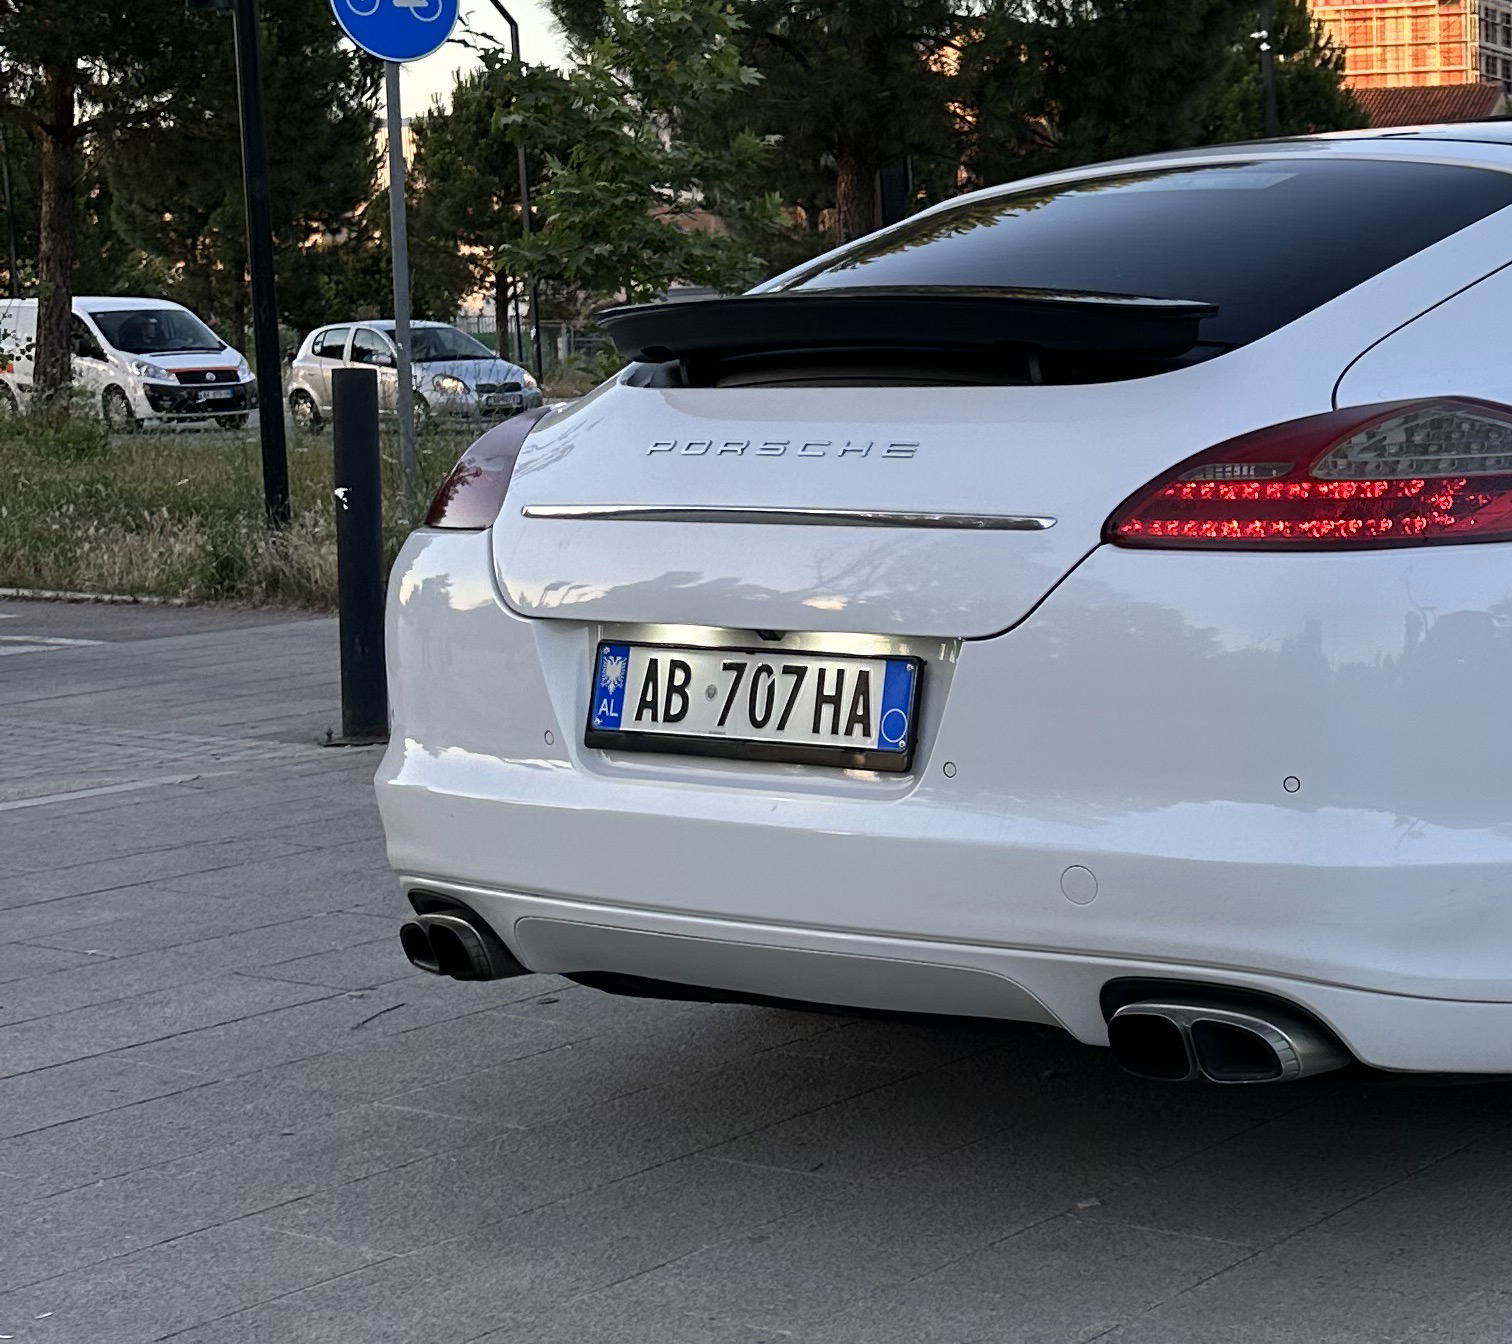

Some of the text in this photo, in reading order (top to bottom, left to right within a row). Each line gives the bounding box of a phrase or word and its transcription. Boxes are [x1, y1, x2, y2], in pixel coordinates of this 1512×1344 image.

[646, 440, 920, 458] PORSCHE
[635, 658, 691, 723] AB
[598, 698, 619, 717] AL
